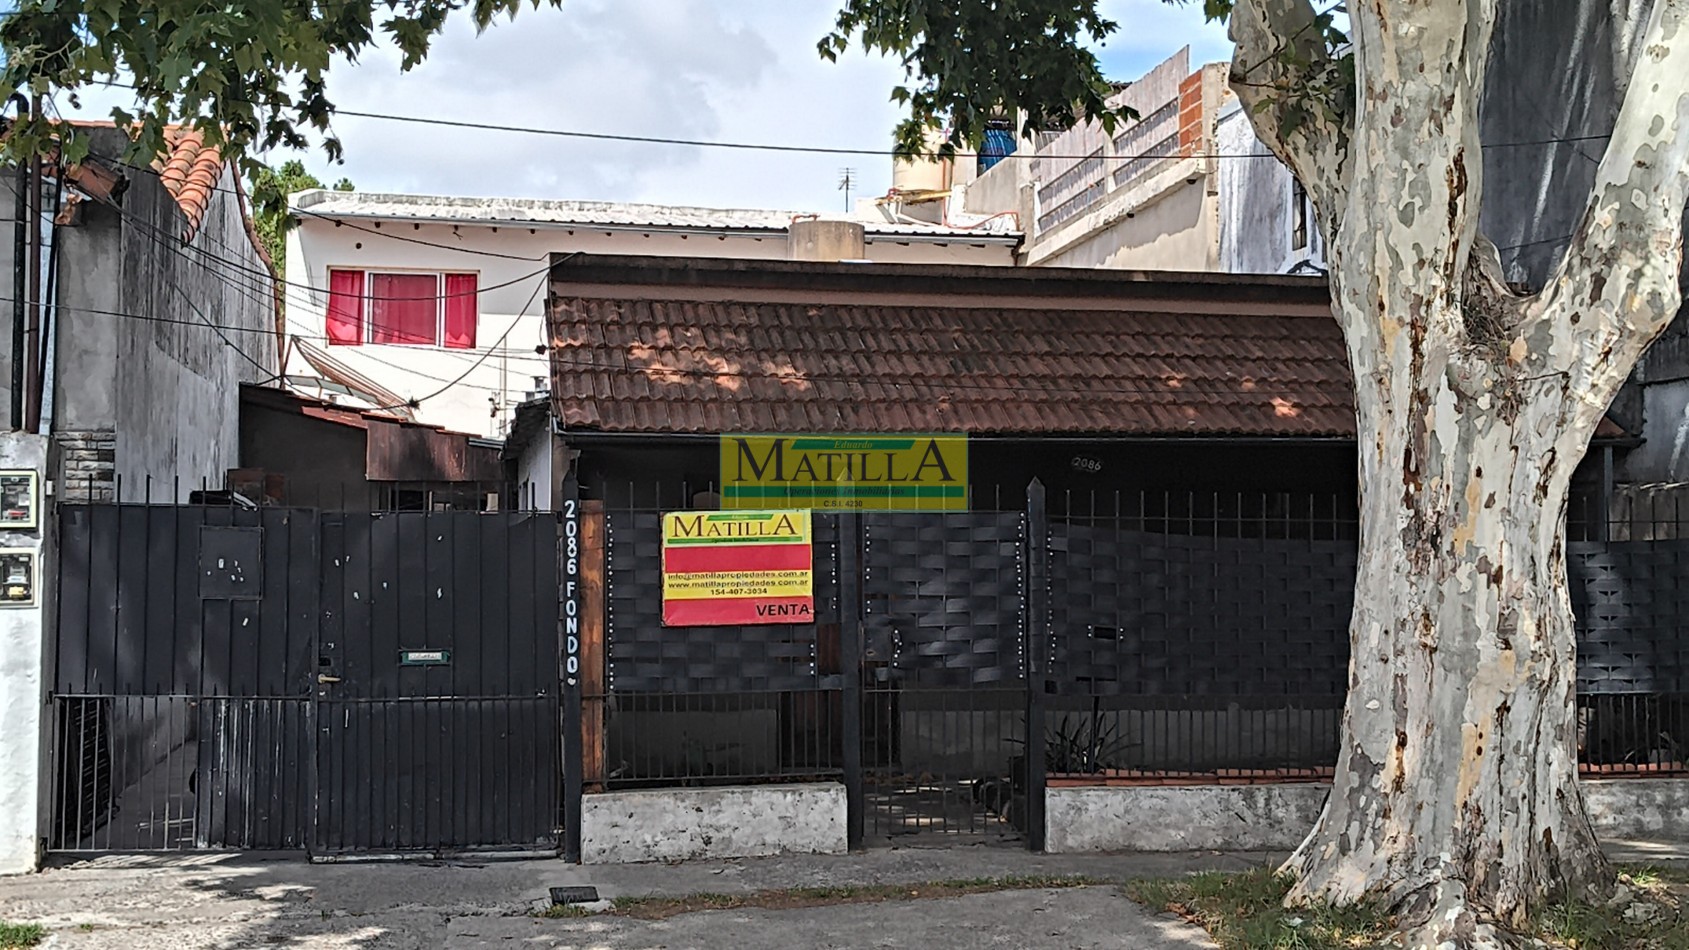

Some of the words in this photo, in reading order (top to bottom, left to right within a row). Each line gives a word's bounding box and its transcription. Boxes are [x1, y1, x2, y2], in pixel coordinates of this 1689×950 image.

[1072, 457, 1102, 471] 2086
[671, 514, 799, 538] MATILLA
[564, 500, 578, 575] 2086
[668, 579, 809, 589] www.matillapropiedades.com.ar
[756, 603, 811, 617] VENTA
